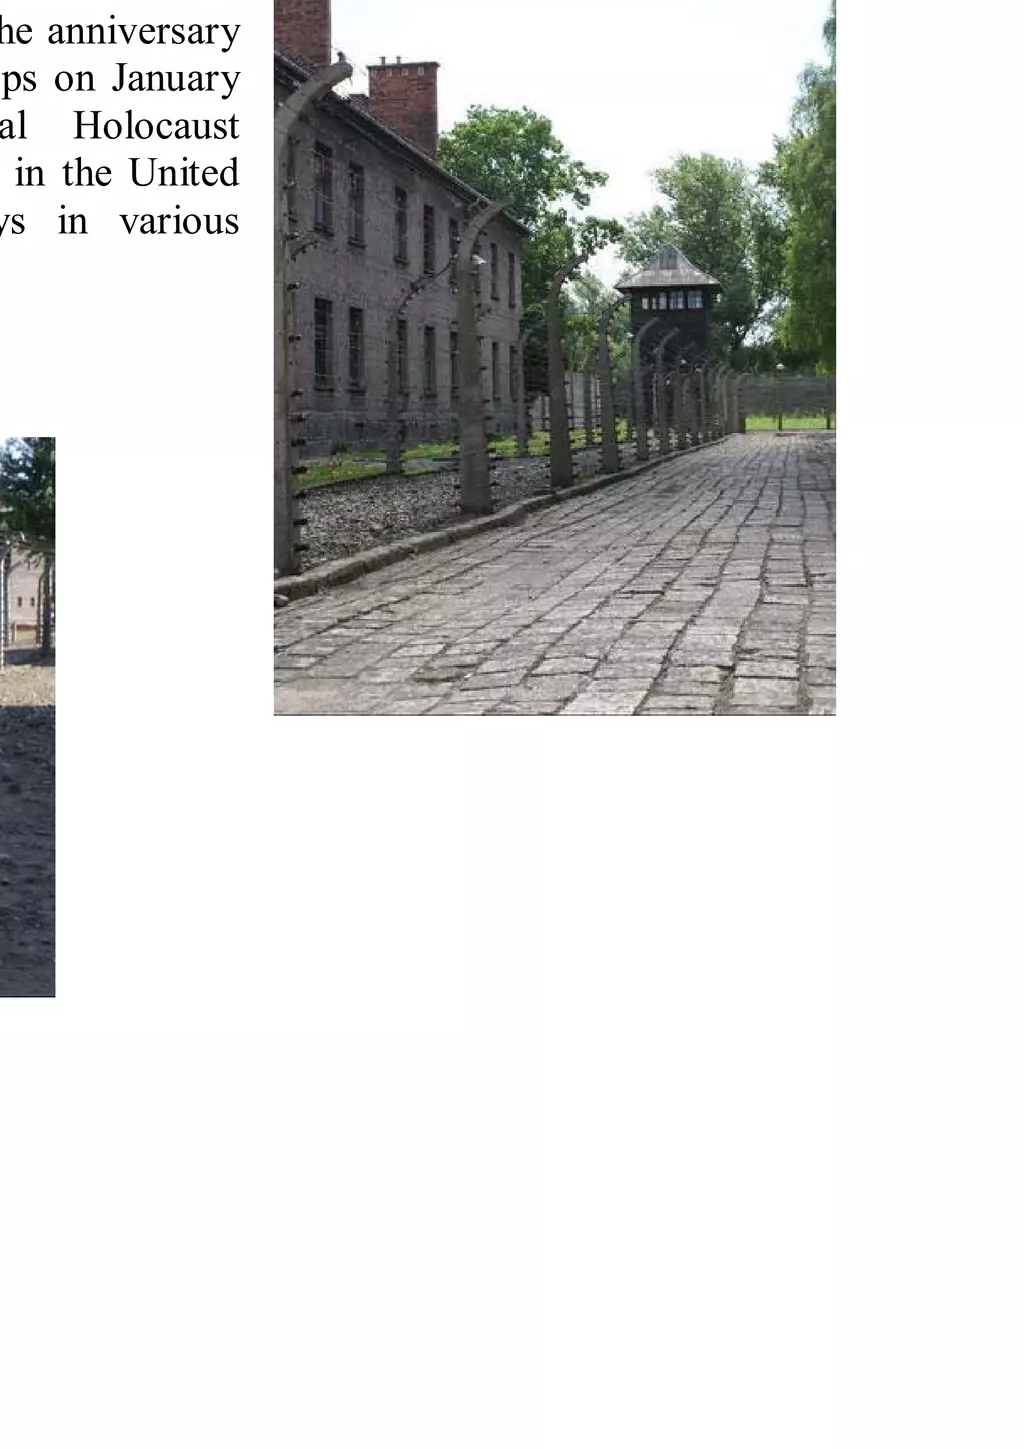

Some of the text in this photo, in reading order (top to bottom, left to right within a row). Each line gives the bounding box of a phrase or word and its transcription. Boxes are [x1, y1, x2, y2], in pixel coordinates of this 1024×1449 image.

[47, 14, 242, 53] anniversary
[54, 70, 96, 92] on
[111, 62, 242, 101] January
[73, 109, 240, 140] Holocaust
[15, 156, 46, 187] in
[62, 156, 112, 187] the
[127, 156, 240, 187] United
